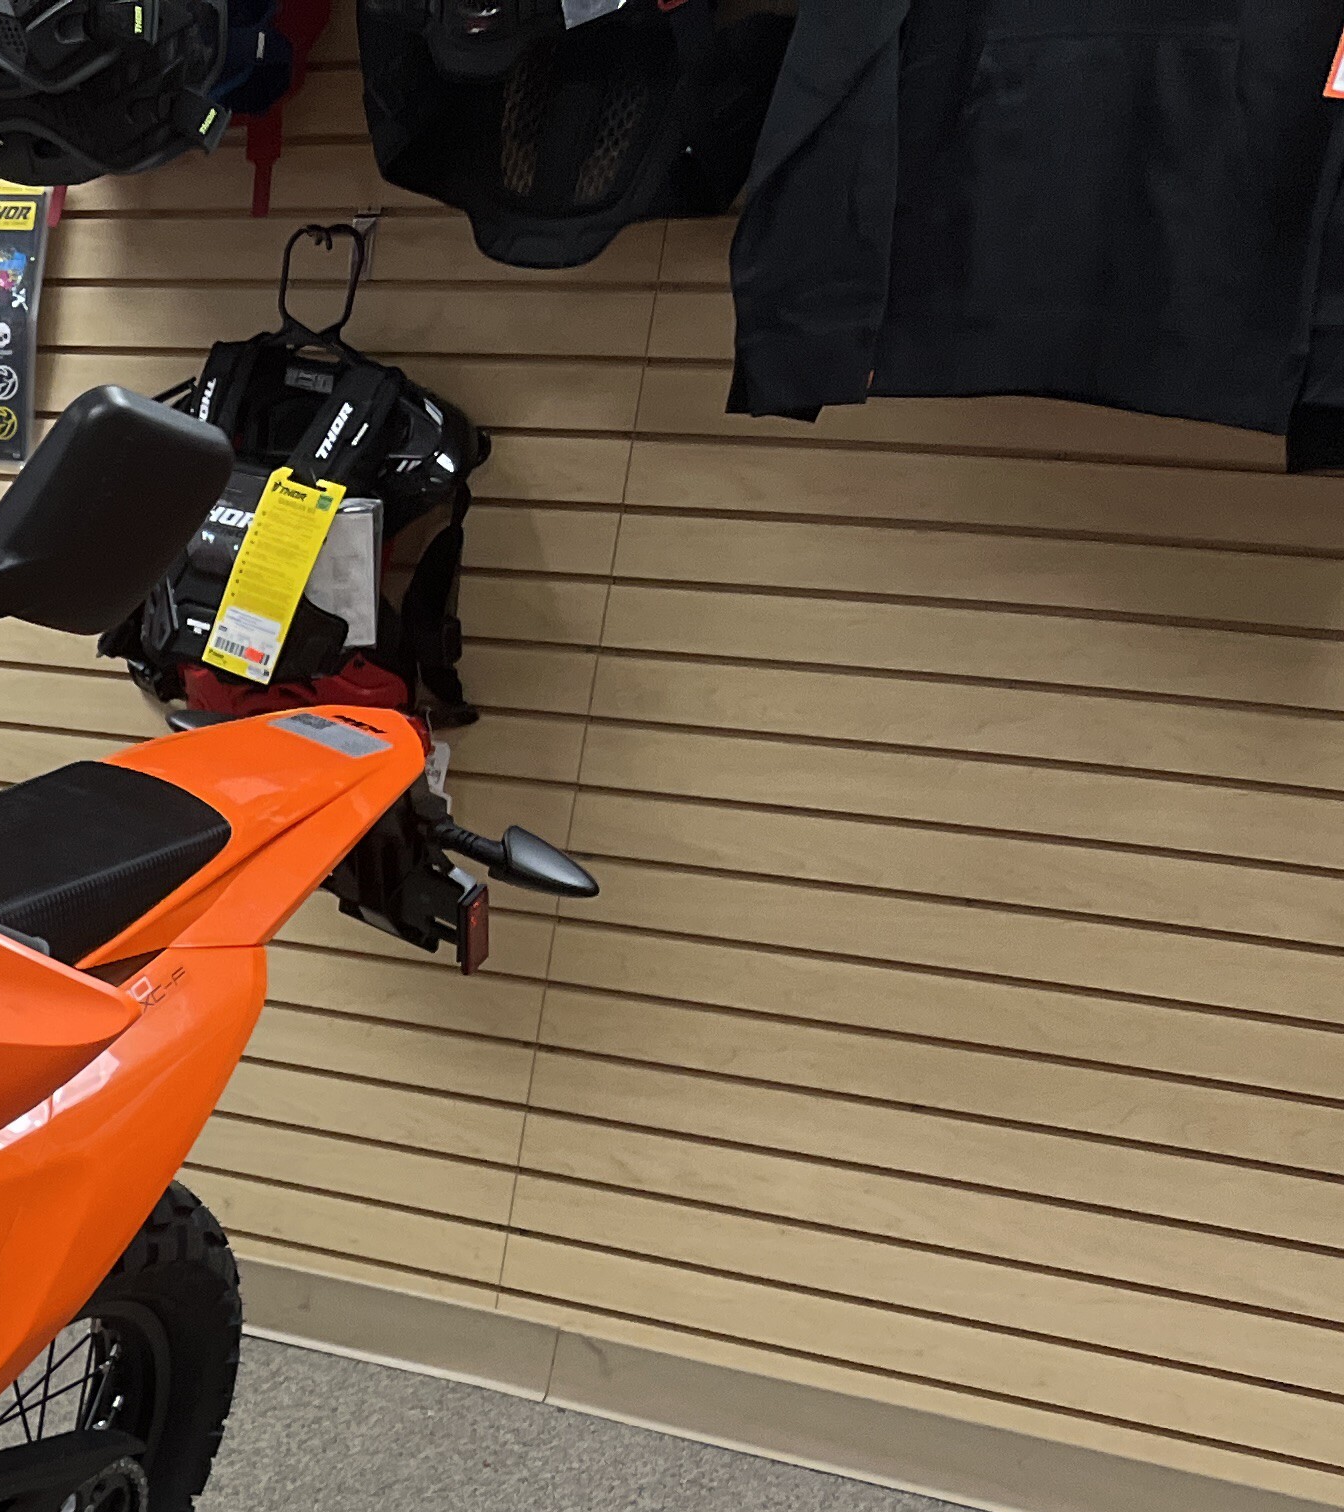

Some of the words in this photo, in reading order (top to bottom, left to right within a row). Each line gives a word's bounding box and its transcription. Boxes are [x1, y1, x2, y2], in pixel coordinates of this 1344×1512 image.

[198, 378, 217, 422] THO
[315, 402, 354, 459] THOR
[138, 966, 186, 1014] XC-F
